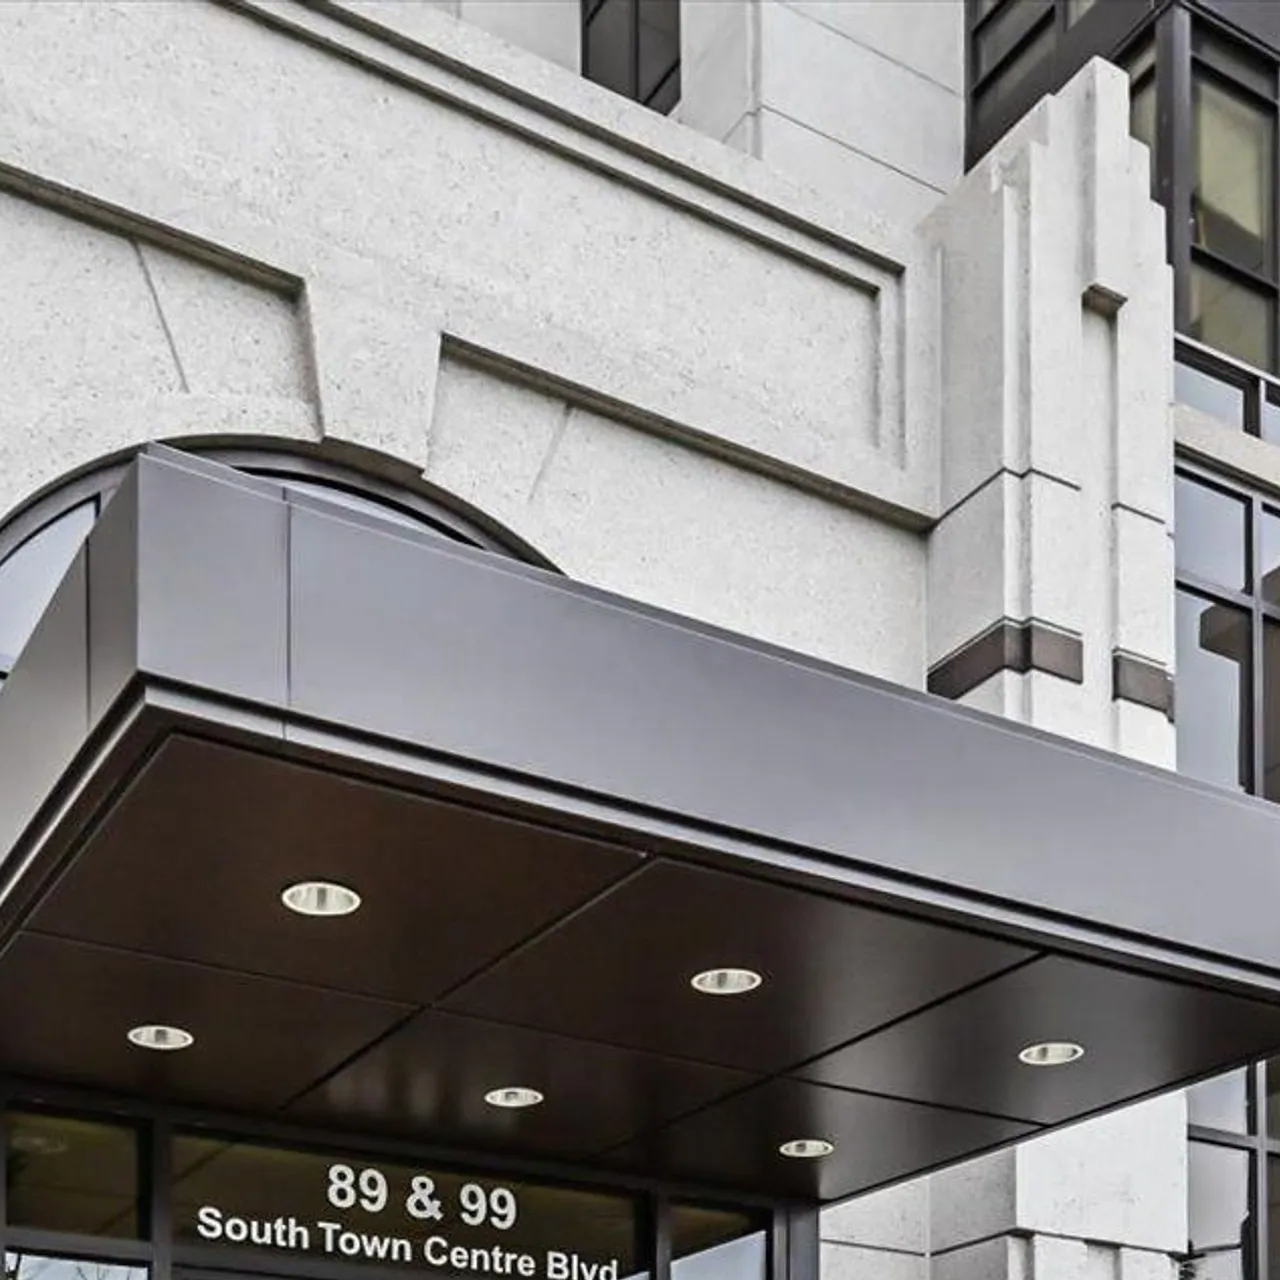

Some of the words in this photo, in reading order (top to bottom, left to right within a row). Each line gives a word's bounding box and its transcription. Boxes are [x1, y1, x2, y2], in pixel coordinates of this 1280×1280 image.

[327, 1163, 388, 1213] 89
[405, 1174, 443, 1222] &
[459, 1183, 518, 1231] 99
[197, 1206, 309, 1250] South
[317, 1221, 412, 1262] Town
[424, 1235, 535, 1277] Centre
